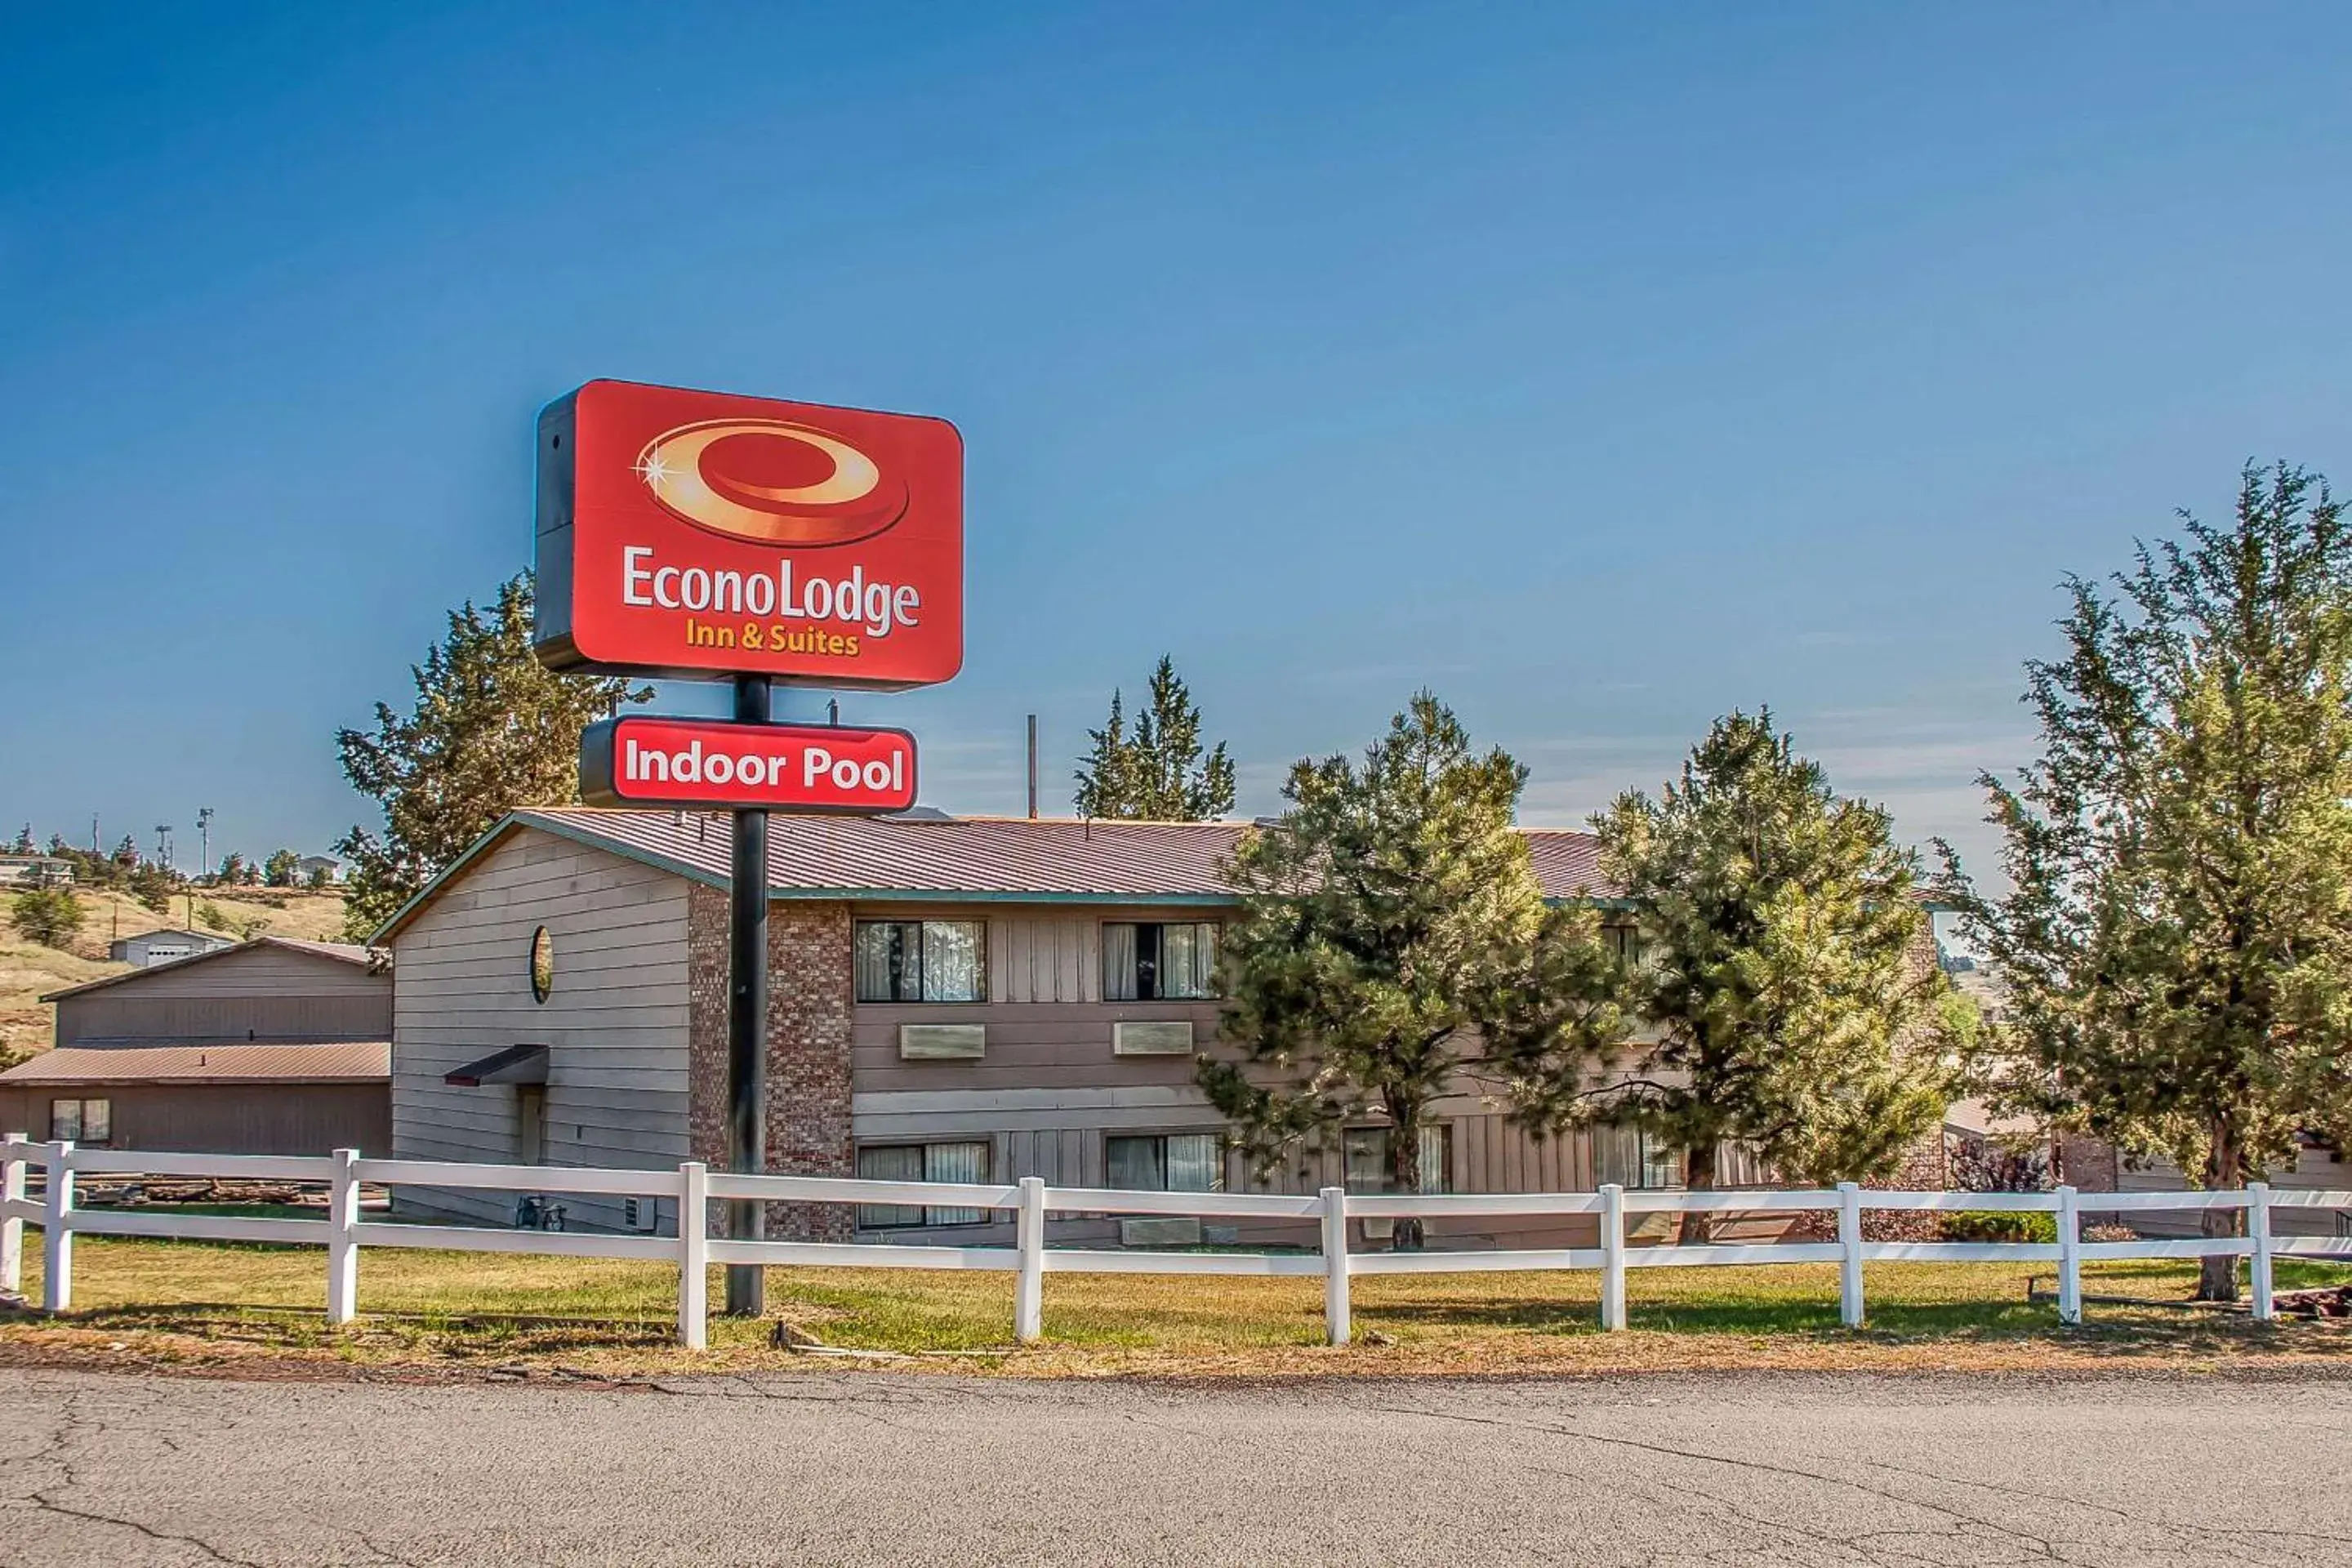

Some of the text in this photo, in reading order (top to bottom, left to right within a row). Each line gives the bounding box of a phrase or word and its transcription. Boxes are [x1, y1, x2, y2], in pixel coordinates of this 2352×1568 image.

[623, 546, 920, 637] EconoLodge
[686, 618, 860, 656] Inn & Suites
[626, 739, 902, 791] Indoor Pool
